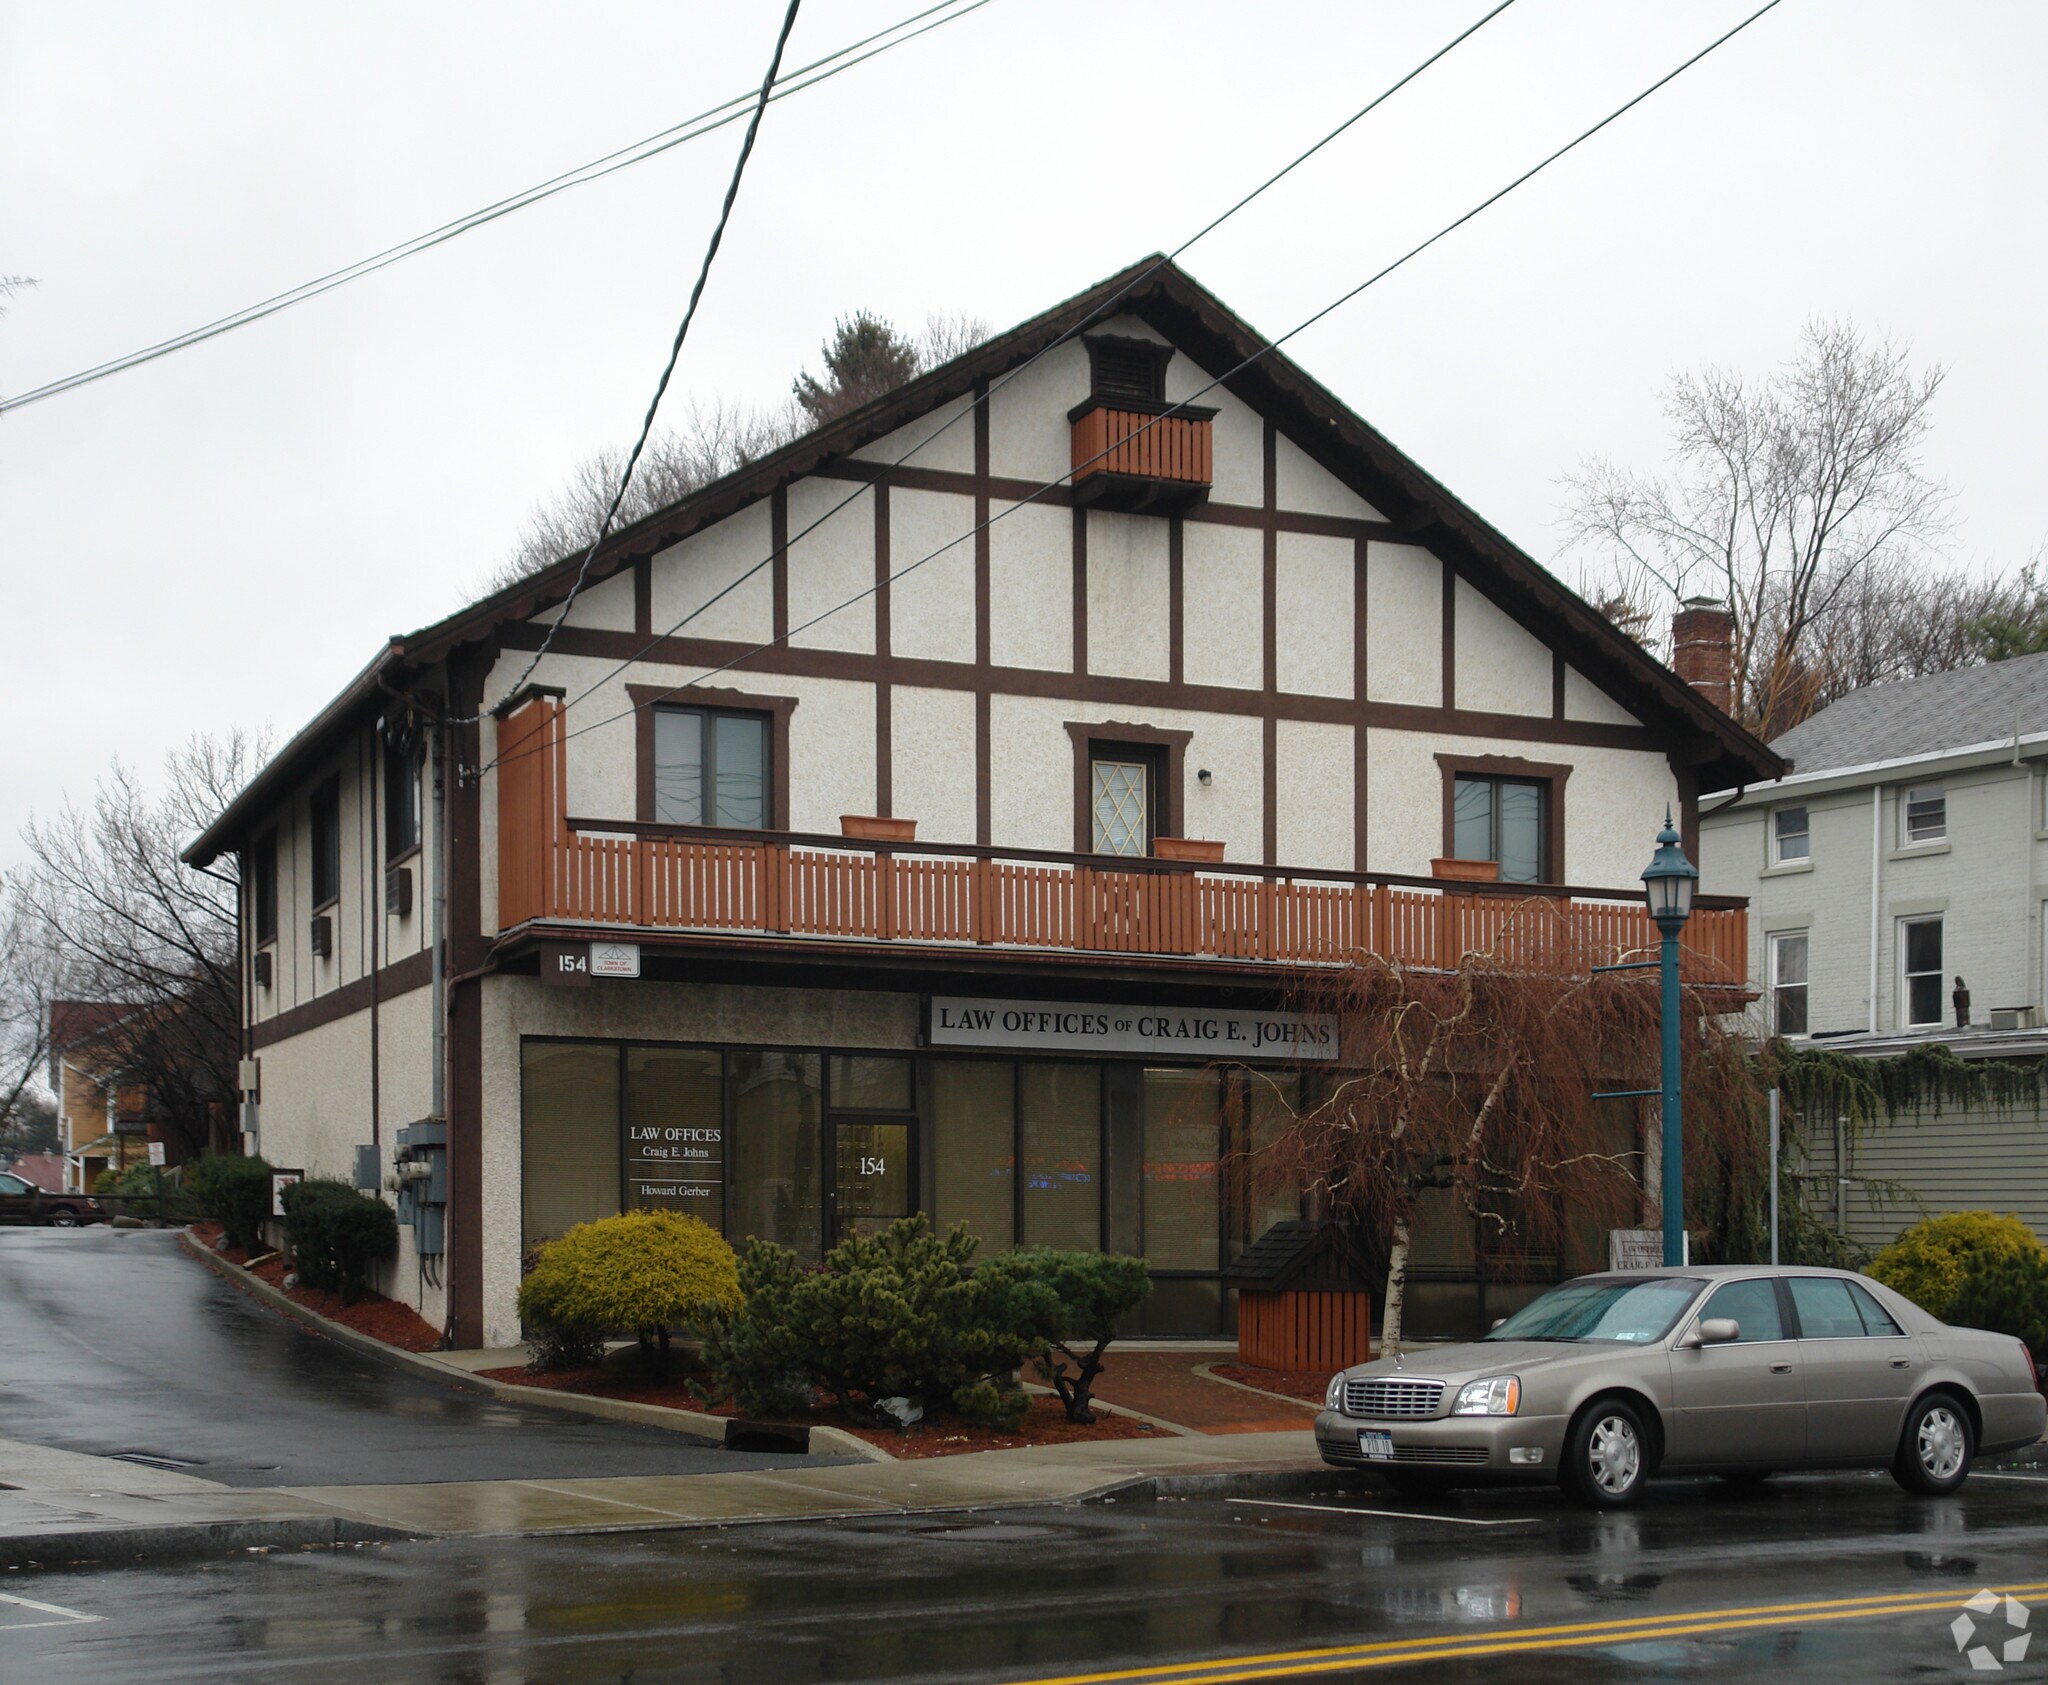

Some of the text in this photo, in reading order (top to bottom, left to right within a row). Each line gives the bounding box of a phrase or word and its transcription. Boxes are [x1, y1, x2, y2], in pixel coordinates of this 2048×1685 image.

[559, 955, 587, 972] 154
[939, 1008, 1331, 1049] LAW OFFICES OF CRAIG E. JOHNS
[630, 1126, 721, 1142] LAW OFFICES
[642, 1146, 709, 1158] Craig E. Johns
[860, 1157, 886, 1175] 154
[641, 1185, 711, 1197] Howard Gerber
